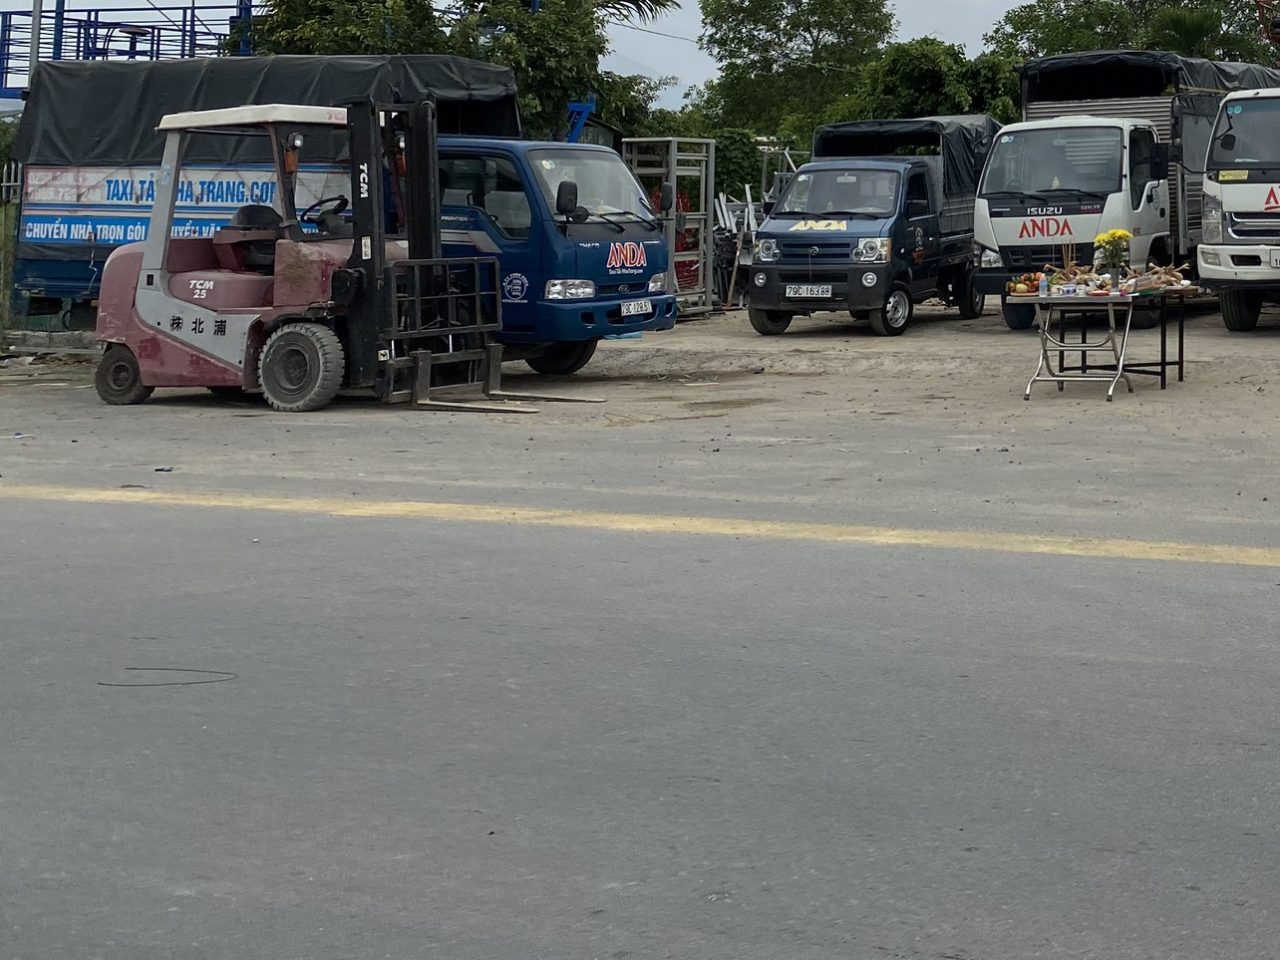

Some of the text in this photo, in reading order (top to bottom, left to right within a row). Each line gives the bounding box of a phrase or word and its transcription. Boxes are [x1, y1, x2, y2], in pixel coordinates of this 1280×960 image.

[106, 179, 134, 201] TAXI
[138, 173, 156, 202] TẢ
[177, 181, 193, 202] HA
[360, 163, 369, 198] TCM
[1027, 207, 1063, 215] ISUZU
[25, 218, 68, 239] CHUYỂN
[95, 225, 124, 243] TRỌN
[127, 222, 146, 240] GÓI
[788, 220, 848, 231] ANDA
[1018, 218, 1073, 239] ANDA
[606, 241, 647, 268] ANDA
[189, 280, 214, 289] TCM
[193, 290, 207, 298] 25
